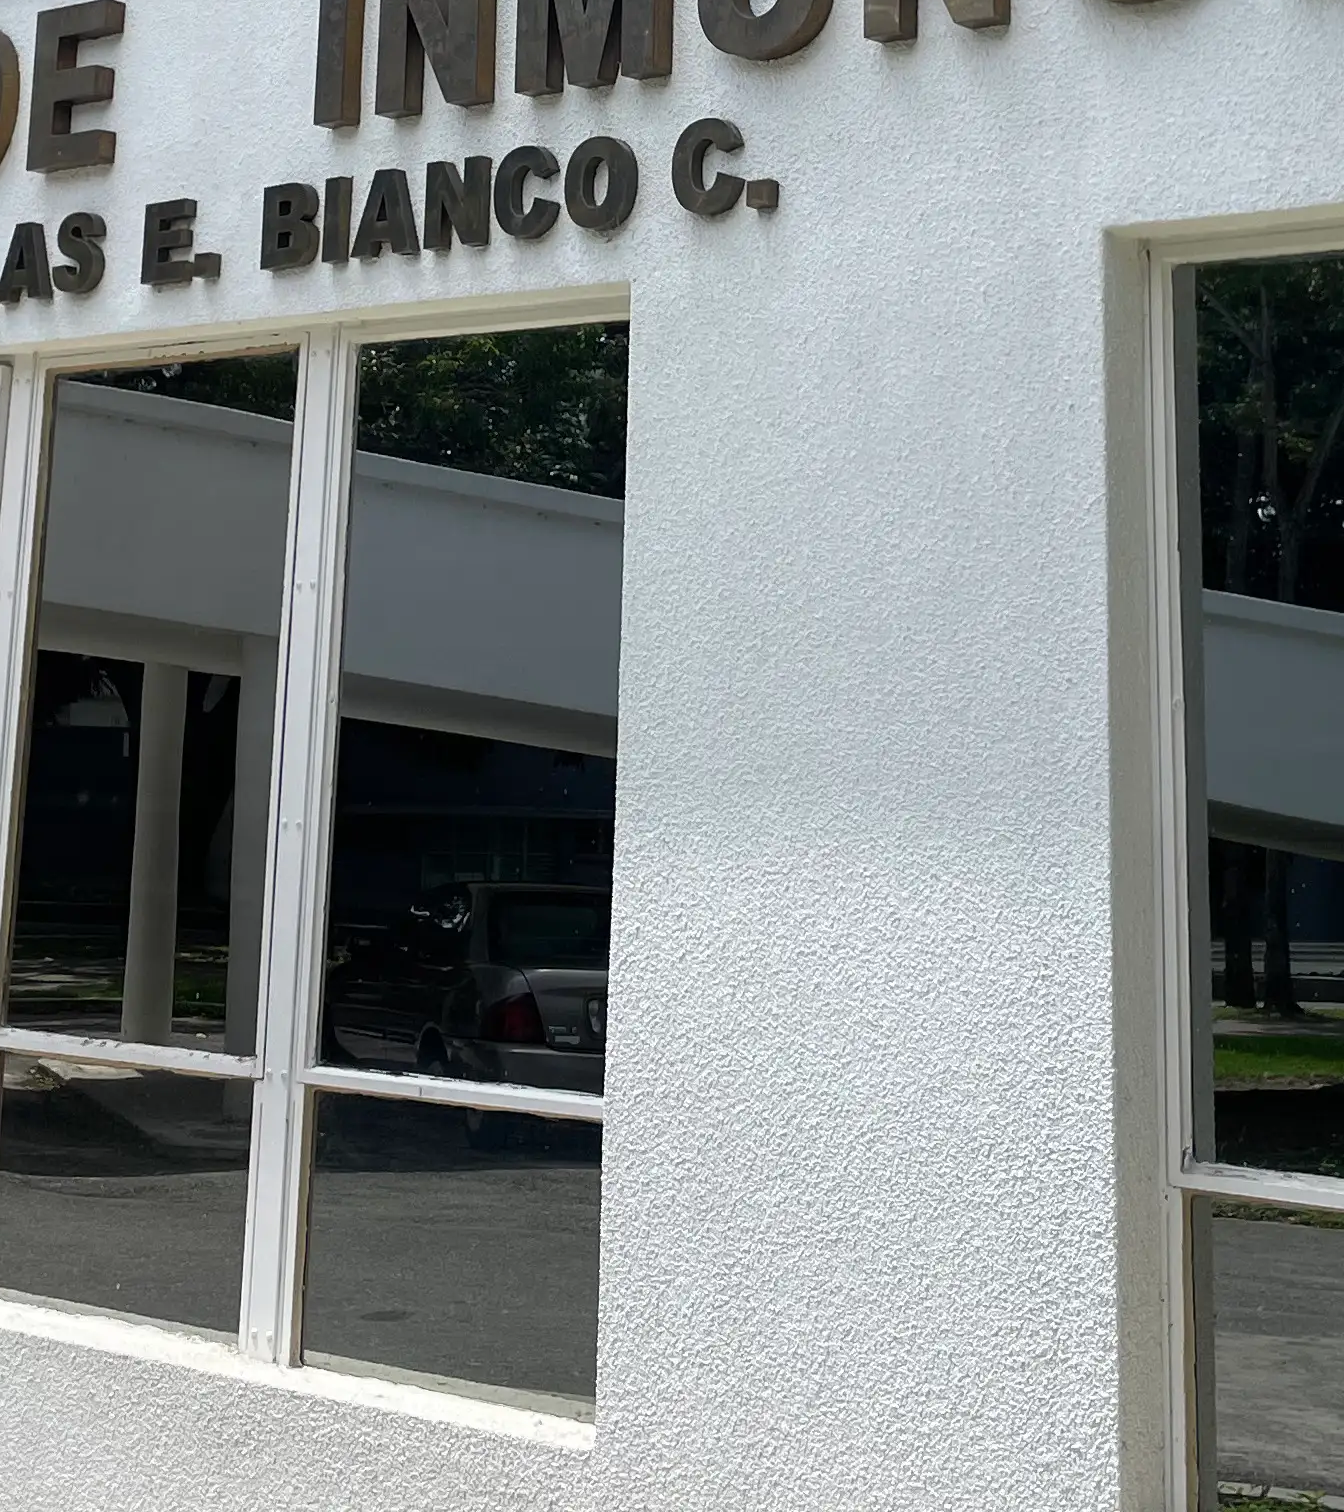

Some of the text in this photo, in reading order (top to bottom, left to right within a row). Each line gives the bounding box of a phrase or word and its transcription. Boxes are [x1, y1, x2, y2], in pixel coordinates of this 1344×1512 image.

[140, 198, 222, 286] E.
[260, 135, 639, 272] BIANCO
[671, 118, 780, 216] C.
